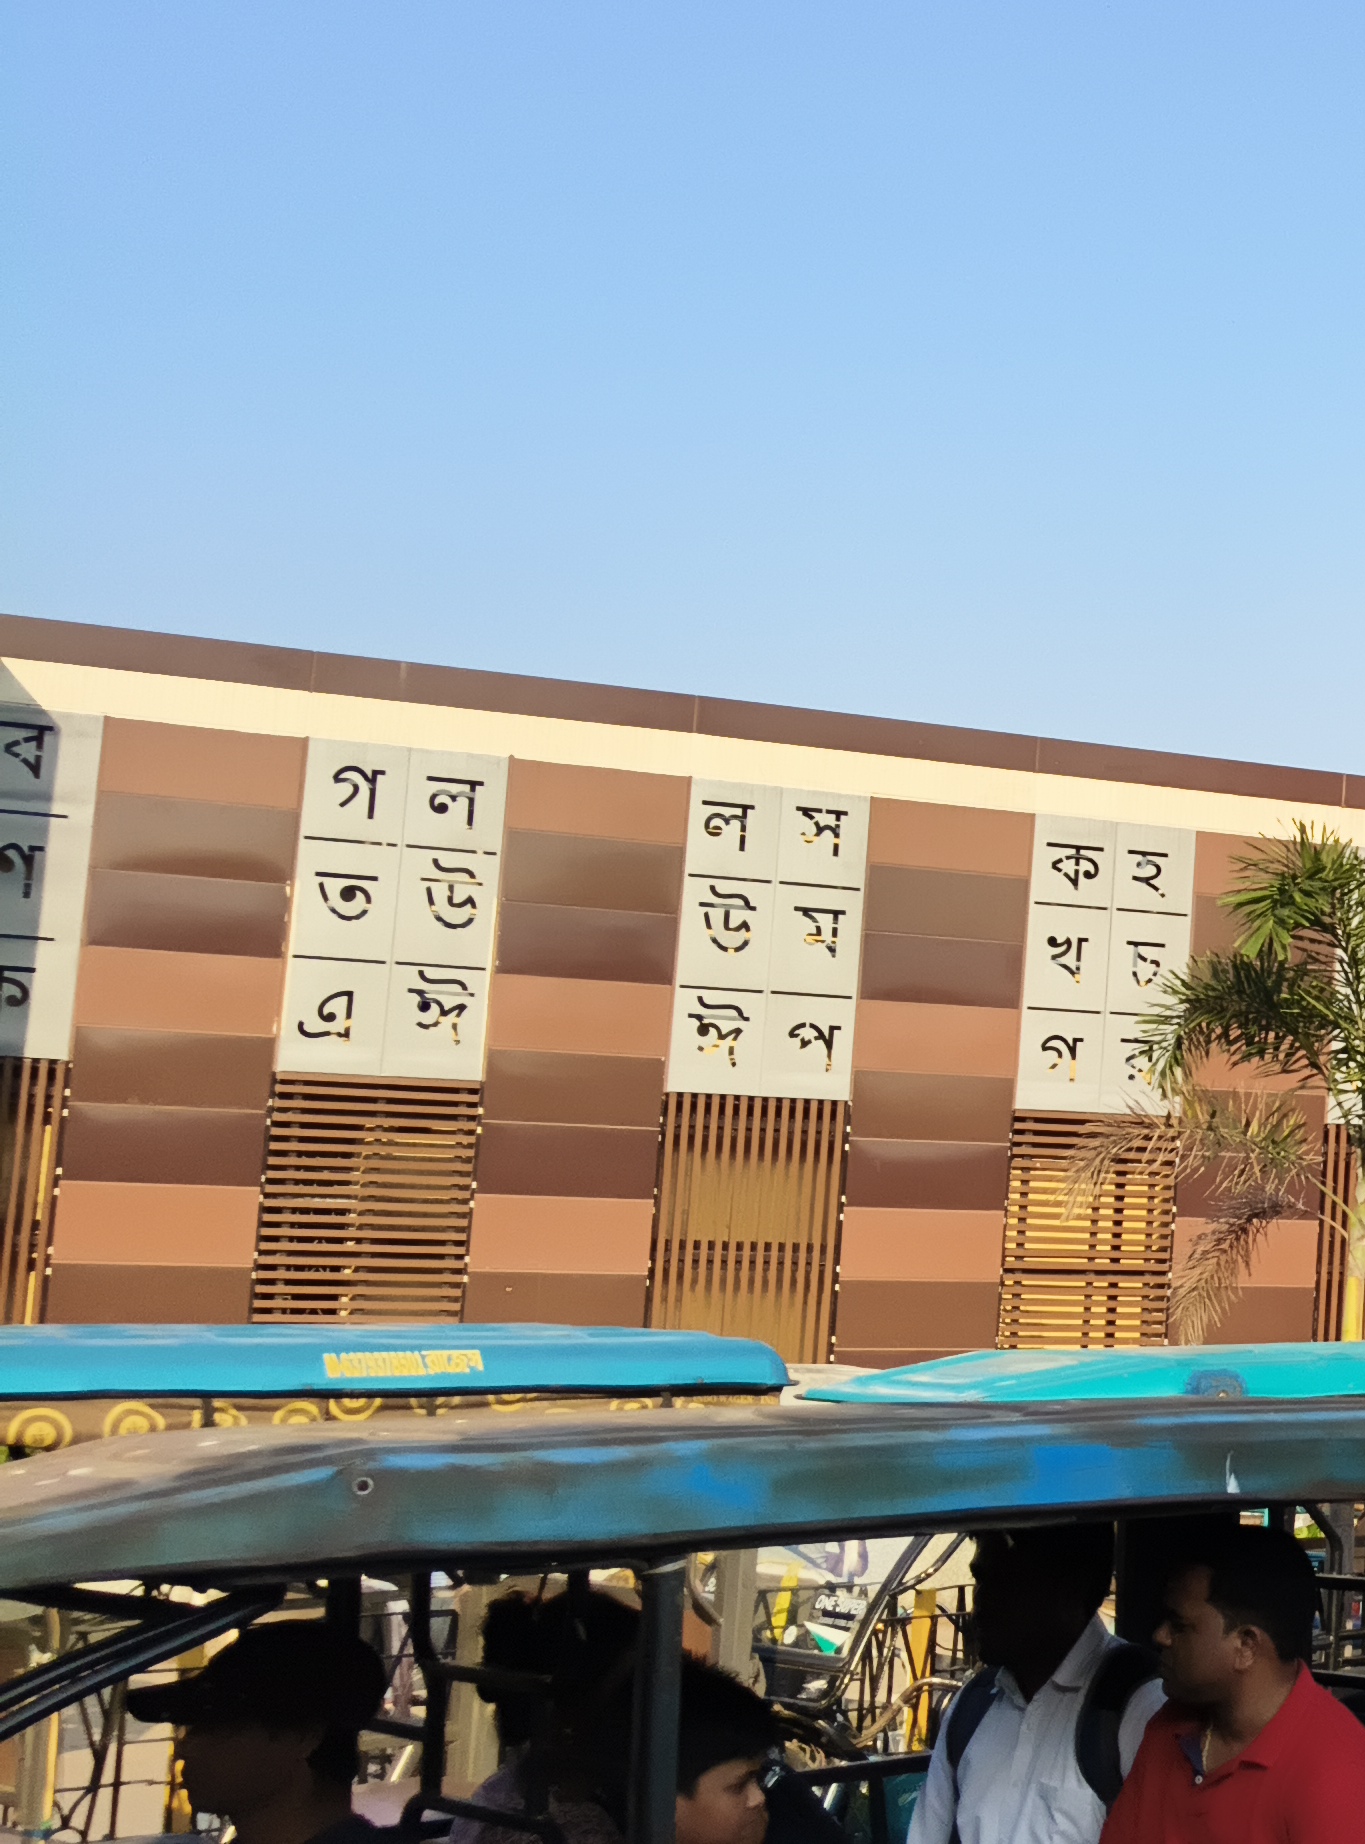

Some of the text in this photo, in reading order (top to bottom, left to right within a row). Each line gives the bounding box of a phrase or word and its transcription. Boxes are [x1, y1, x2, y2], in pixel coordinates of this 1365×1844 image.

[333, 765, 484, 829] গ ল
[702, 800, 848, 857] ল স
[315, 858, 483, 929] ত উ
[1046, 841, 1169, 898] ক হ
[698, 884, 757, 953] উ
[1047, 935, 1089, 984] খ
[298, 970, 475, 1045] এ ঈ
[687, 996, 750, 1067] ঈ
[1041, 1034, 1084, 1083] গ
